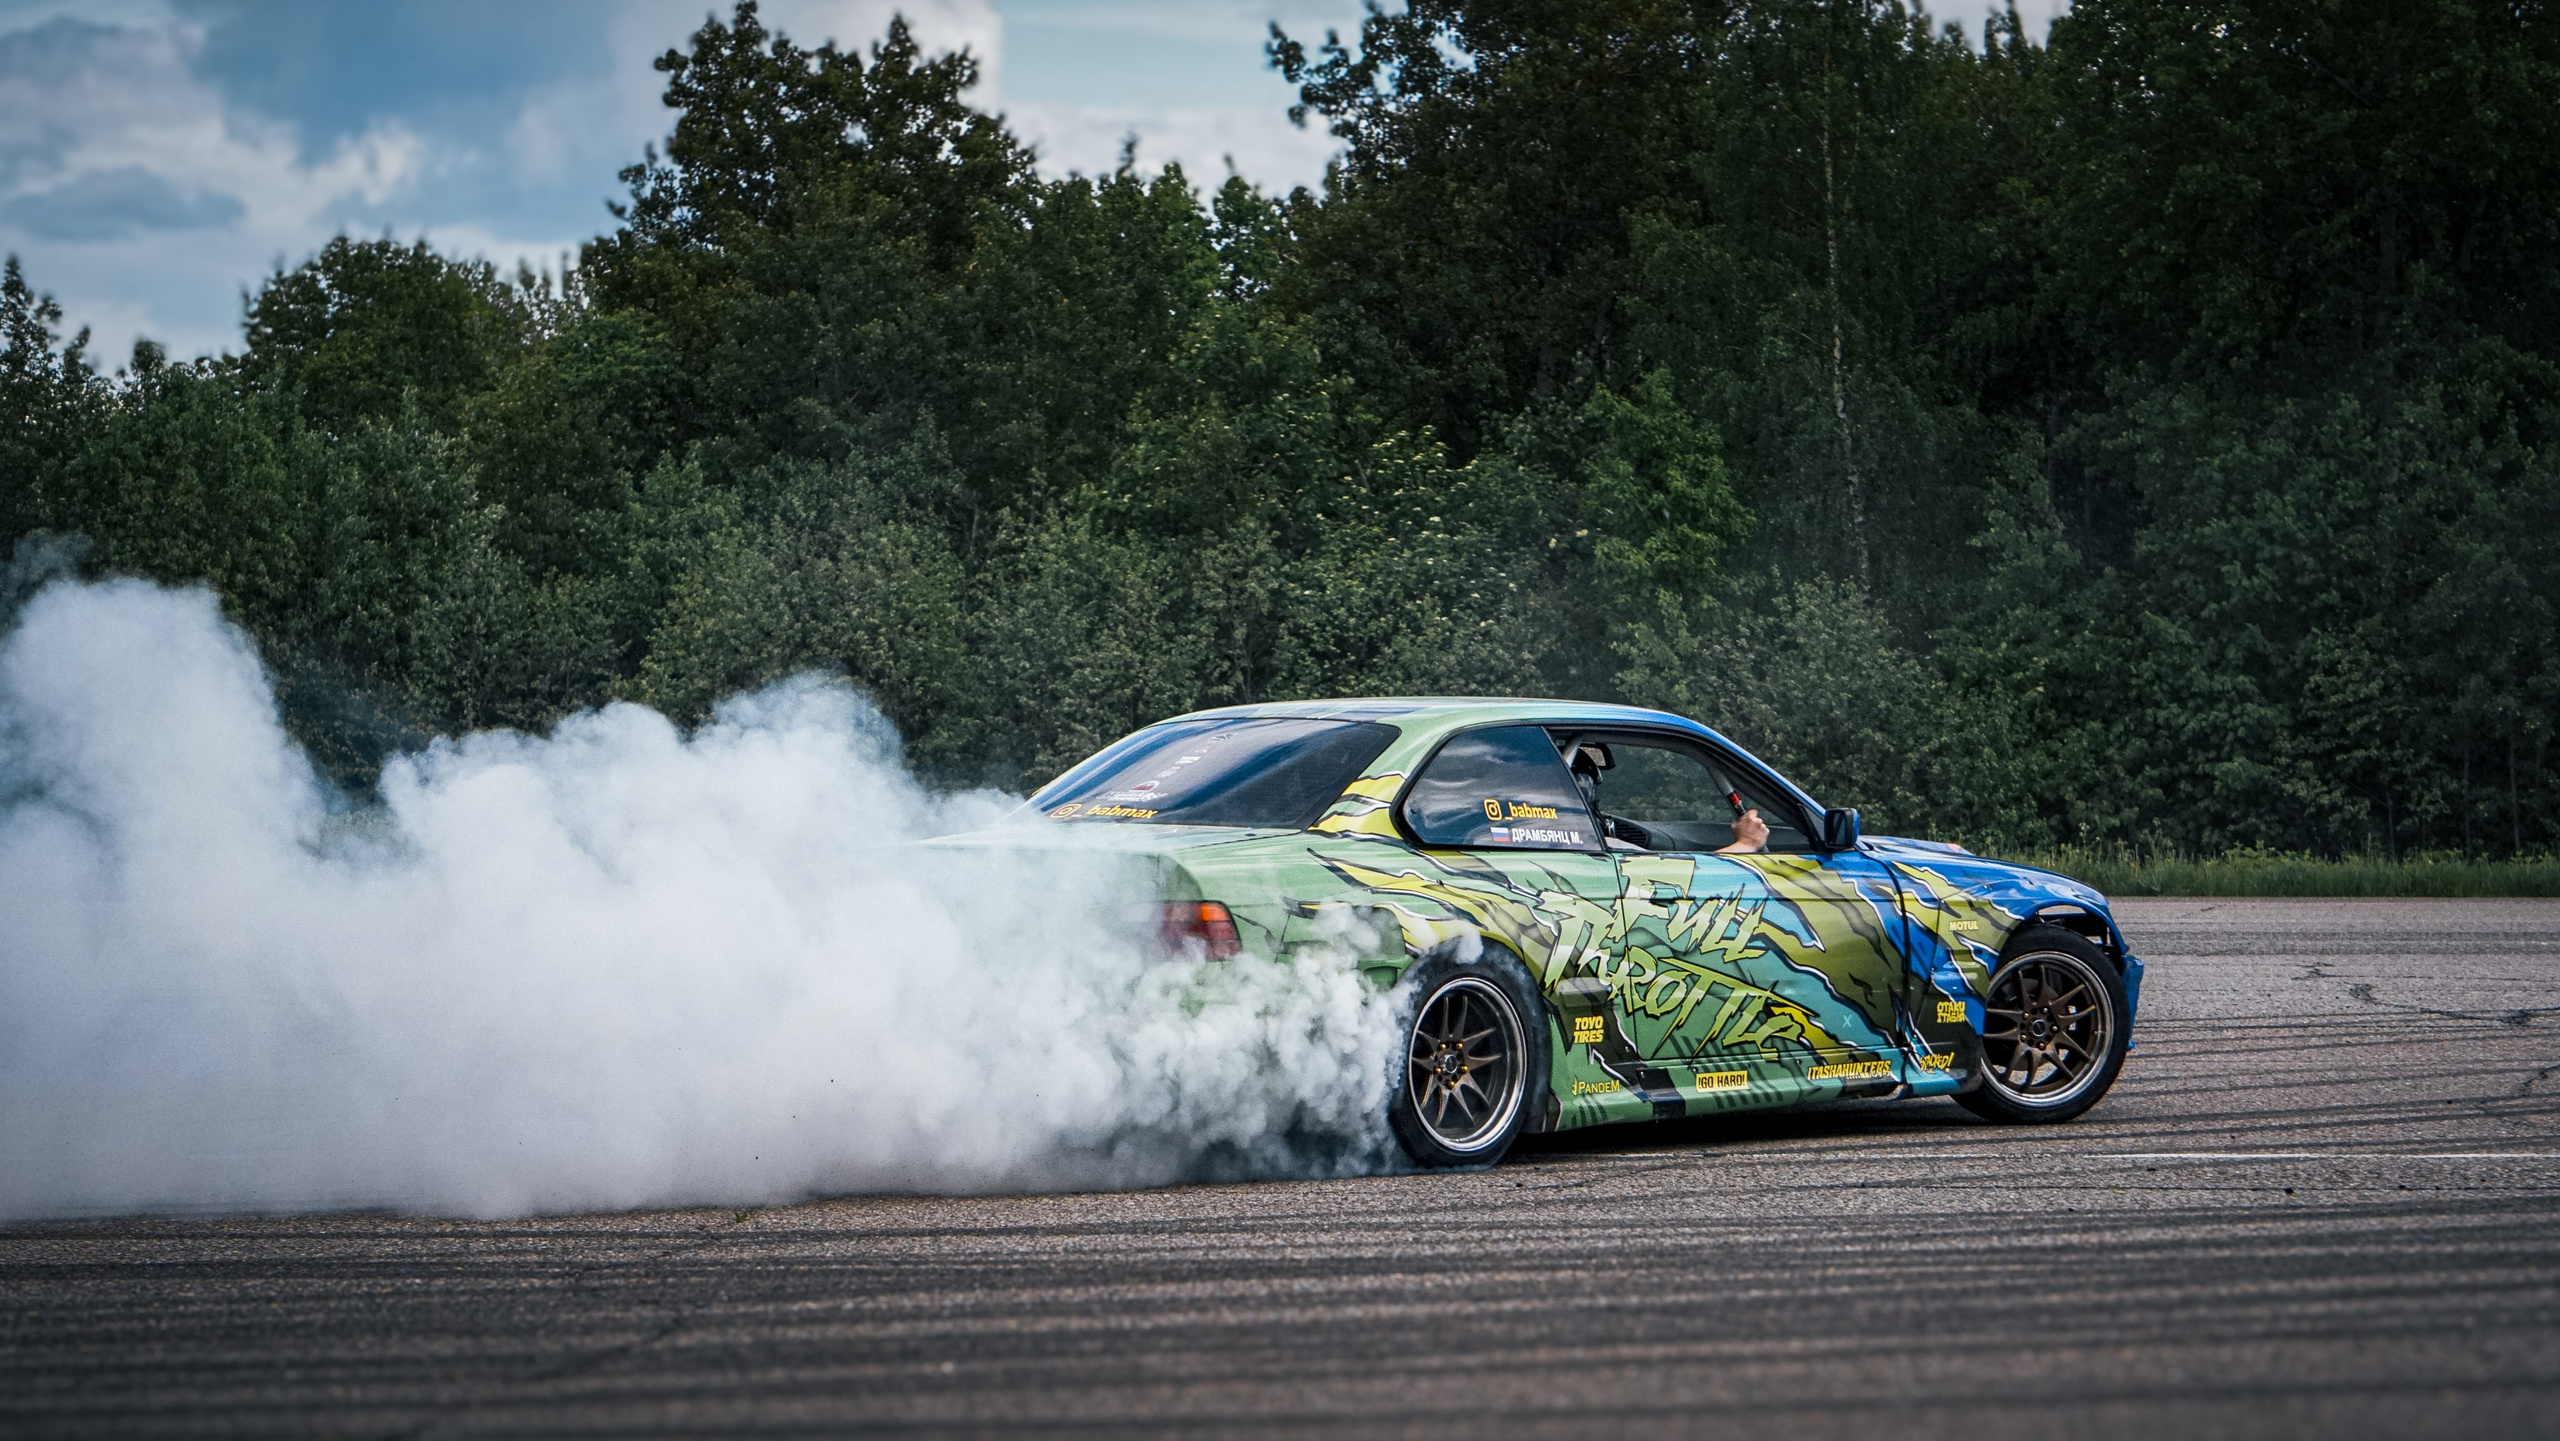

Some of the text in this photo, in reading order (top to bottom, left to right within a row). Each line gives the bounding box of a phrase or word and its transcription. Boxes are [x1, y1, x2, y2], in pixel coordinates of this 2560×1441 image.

[1505, 802, 1558, 820] _babmax
[1511, 828, 1584, 845] ДРАМБЯНЦ М.
[1949, 920, 1979, 931] MOTUL
[1936, 1001, 1966, 1013] OTAKU
[1574, 1016, 1604, 1030] TOYO
[1573, 1030, 1604, 1043] TIRES
[1807, 1060, 1892, 1080] ITASHAHUNTERS
[1698, 1074, 1746, 1089] !GO HARD!
